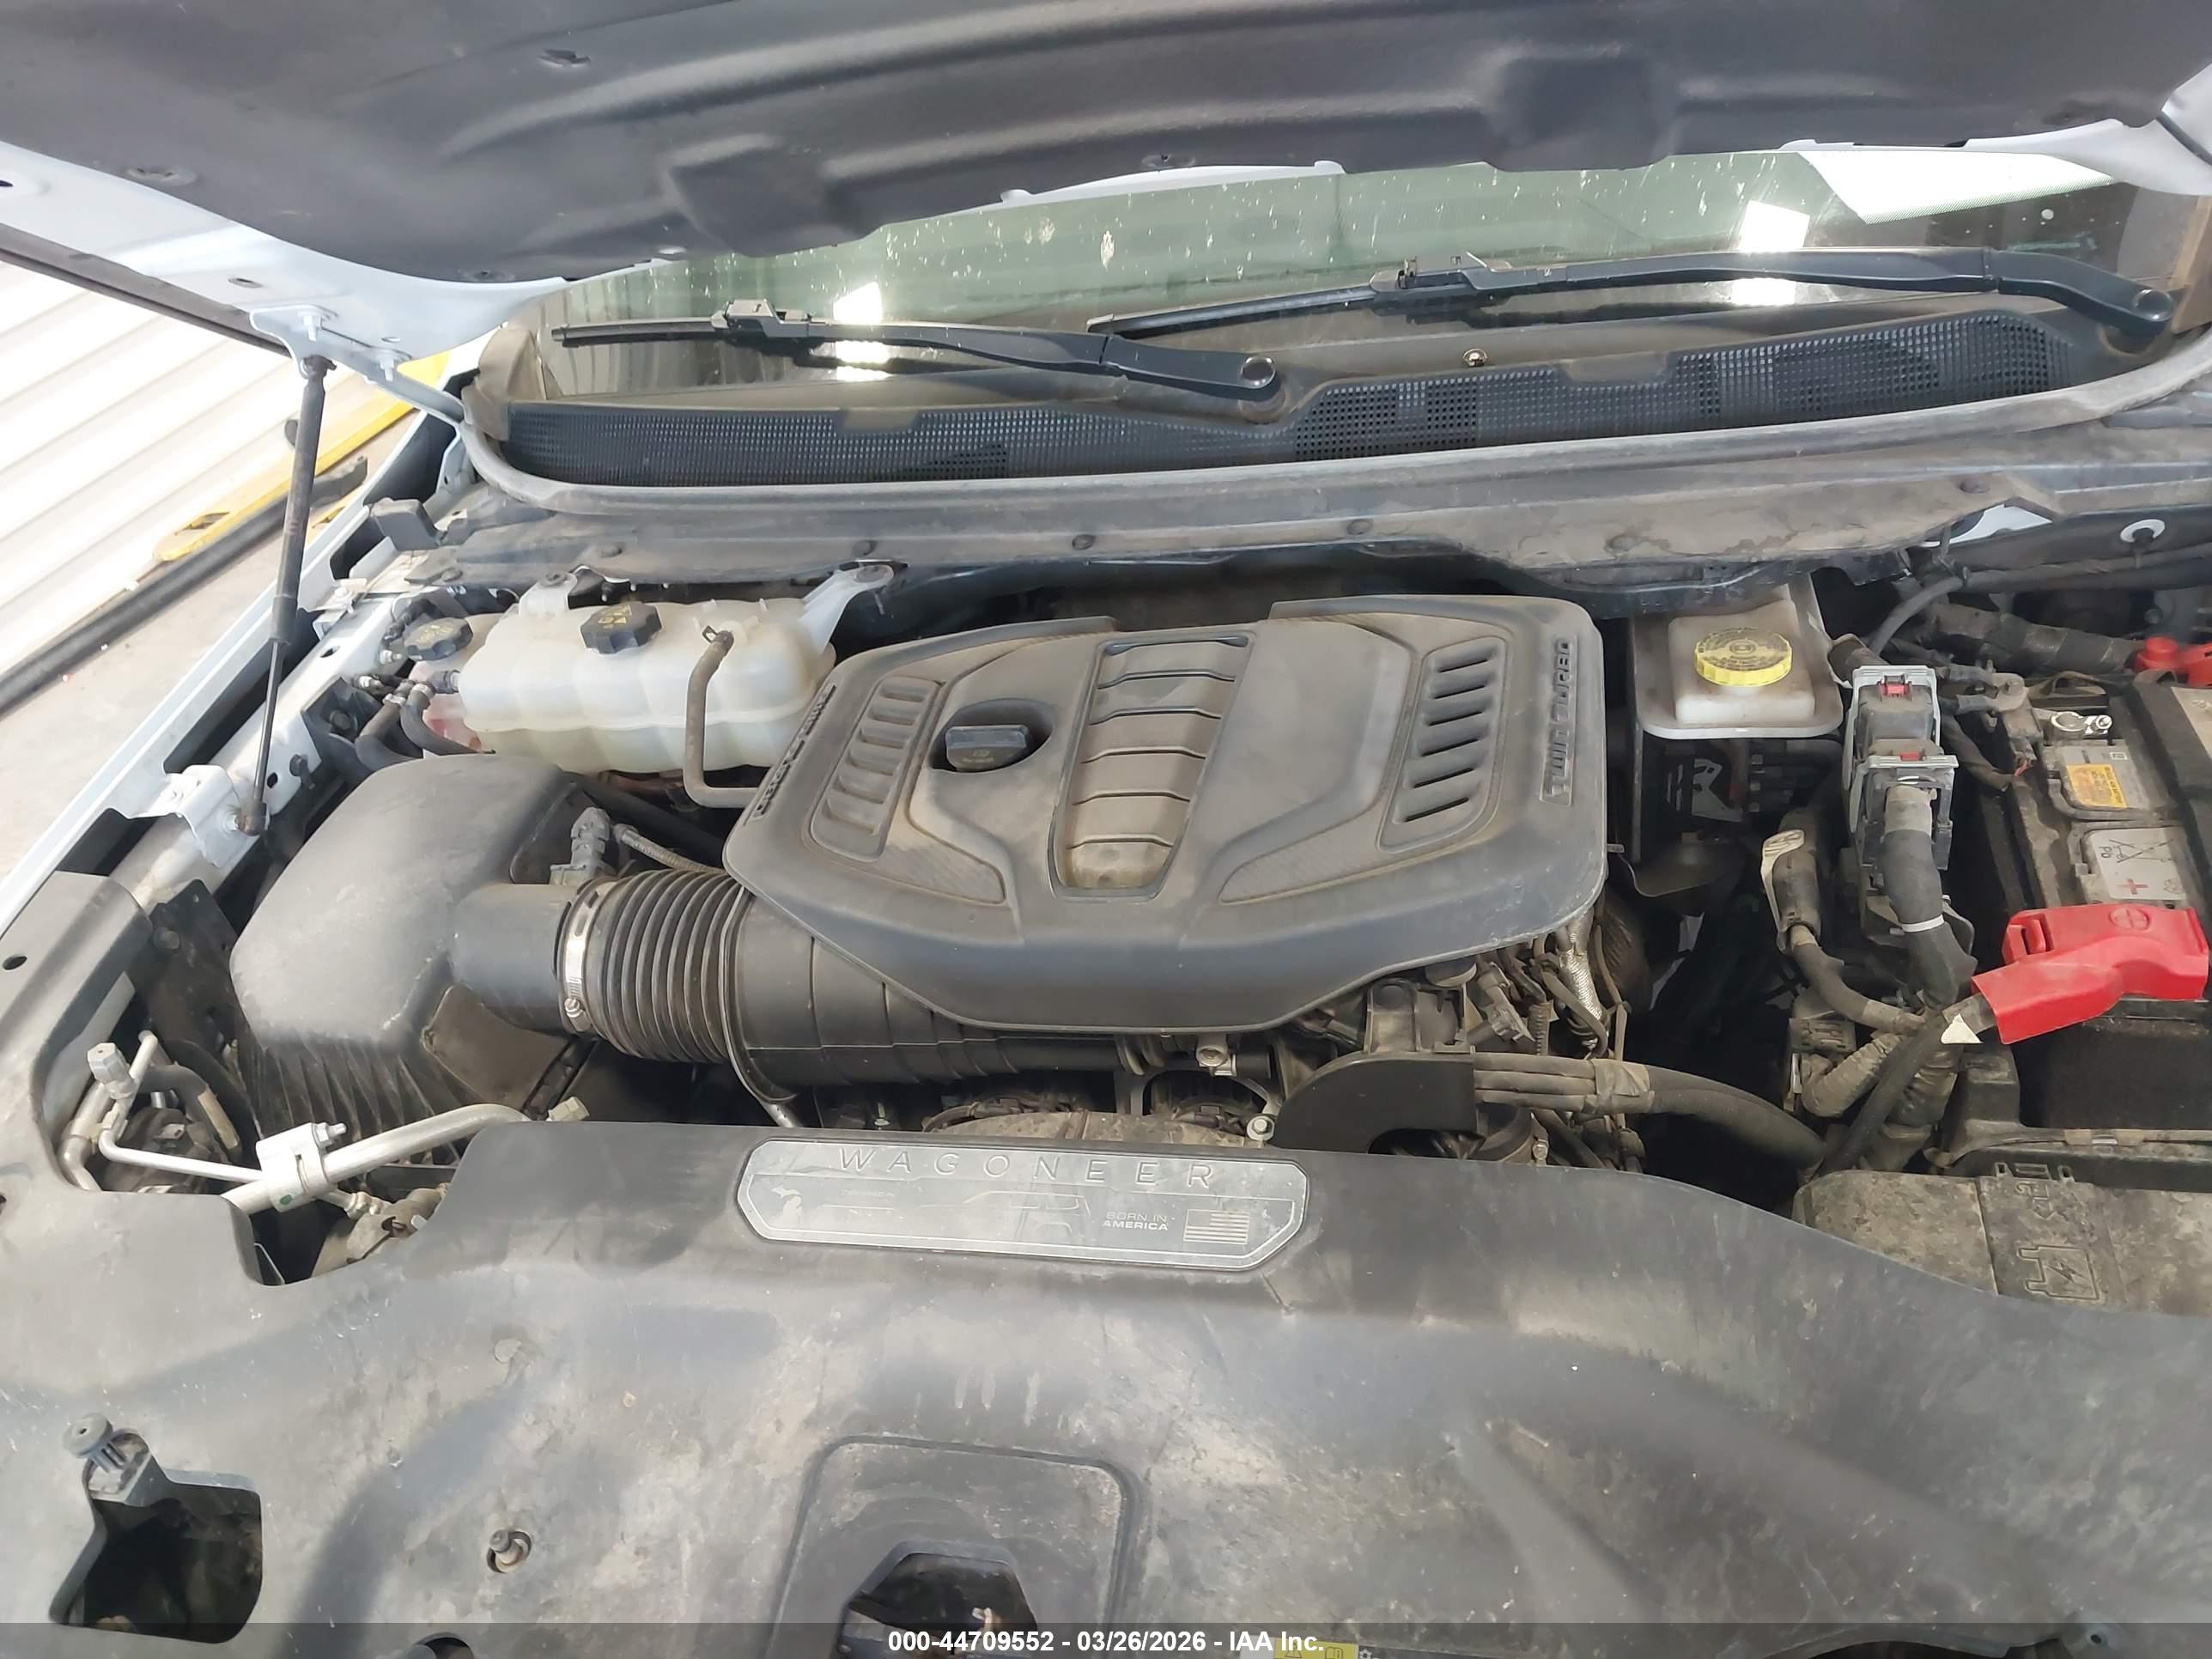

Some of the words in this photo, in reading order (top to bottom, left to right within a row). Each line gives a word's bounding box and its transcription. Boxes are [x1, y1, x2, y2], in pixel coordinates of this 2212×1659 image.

[839, 1147, 1213, 1188] WAGONEER
[1105, 1211, 1147, 1221] BORN
[1153, 1213, 1167, 1223] IN
[1102, 1219, 1169, 1231] AMERICA
